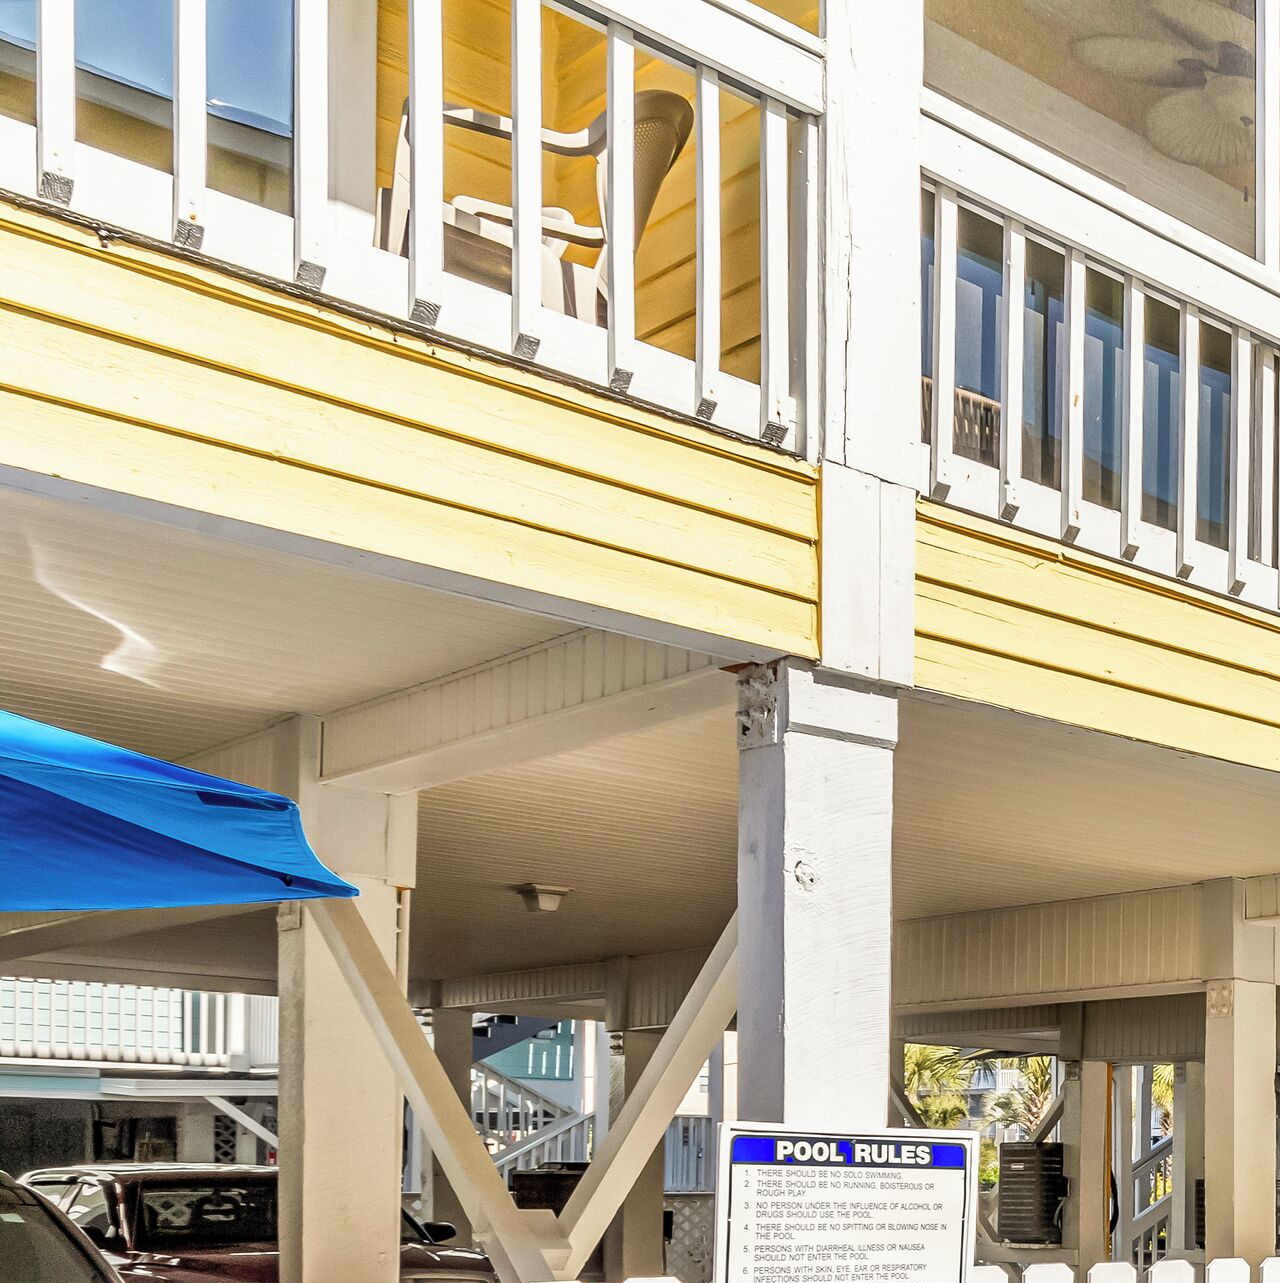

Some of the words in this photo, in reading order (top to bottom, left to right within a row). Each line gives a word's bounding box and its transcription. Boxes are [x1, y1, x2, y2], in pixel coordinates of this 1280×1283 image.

[776, 1140, 844, 1162] POOL
[854, 1143, 930, 1165] RULES
[756, 1169, 783, 1178] THERE
[785, 1169, 817, 1178] SHOULD
[818, 1169, 829, 1178] BE
[830, 1170, 842, 1179] NO
[843, 1170, 864, 1179] SOLO
[756, 1180, 783, 1188] THERE
[785, 1180, 817, 1189] SHOULD
[818, 1180, 829, 1189] BE
[830, 1181, 842, 1189] NO
[879, 1182, 923, 1190] BOISTEROUS
[924, 1182, 935, 1190] OR
[756, 1189, 786, 1197] ROUGH
[755, 1202, 769, 1210] NO
[770, 1202, 803, 1210] PERSON
[804, 1202, 831, 1210] UNDER
[832, 1202, 848, 1210] THE
[849, 1202, 888, 1210] INFLUENCE
[889, 1202, 900, 1210] OF
[900, 1202, 932, 1210] ALCOHOL
[755, 1210, 785, 1219] DRUGS
[786, 1210, 818, 1219] SHOULD
[819, 1210, 835, 1219] USE
[836, 1210, 851, 1219] THE
[755, 1223, 782, 1231] THERE
[784, 1223, 816, 1231] SHOULD
[817, 1223, 828, 1231] BE
[829, 1223, 841, 1231] NO
[842, 1223, 874, 1231] SPITTING
[875, 1223, 886, 1231] OR
[887, 1223, 919, 1231] BLOWING
[920, 1223, 939, 1231] NOSE
[940, 1223, 948, 1231] IN
[755, 1232, 772, 1240] THE
[754, 1244, 793, 1252] PERSONS
[794, 1244, 814, 1252] WITH
[815, 1244, 856, 1252] DIARRHEAL
[857, 1244, 885, 1252] ILLNESS
[898, 1243, 926, 1251] NAUSEA
[753, 1253, 787, 1262] SHOULD
[789, 1253, 805, 1261] NOT
[807, 1253, 832, 1261] ENTER
[833, 1252, 848, 1261] THE
[753, 1266, 792, 1274] PERSONS
[793, 1265, 813, 1274] WITH
[853, 1265, 868, 1273] EAR
[869, 1264, 880, 1272] OR
[881, 1263, 928, 1272] RESPIRATORY
[753, 1274, 800, 1283] INFECTIONS
[802, 1274, 833, 1283] SHOULD
[834, 1273, 850, 1282] NOT
[851, 1273, 874, 1281] ENTER
[875, 1273, 889, 1281] THE
